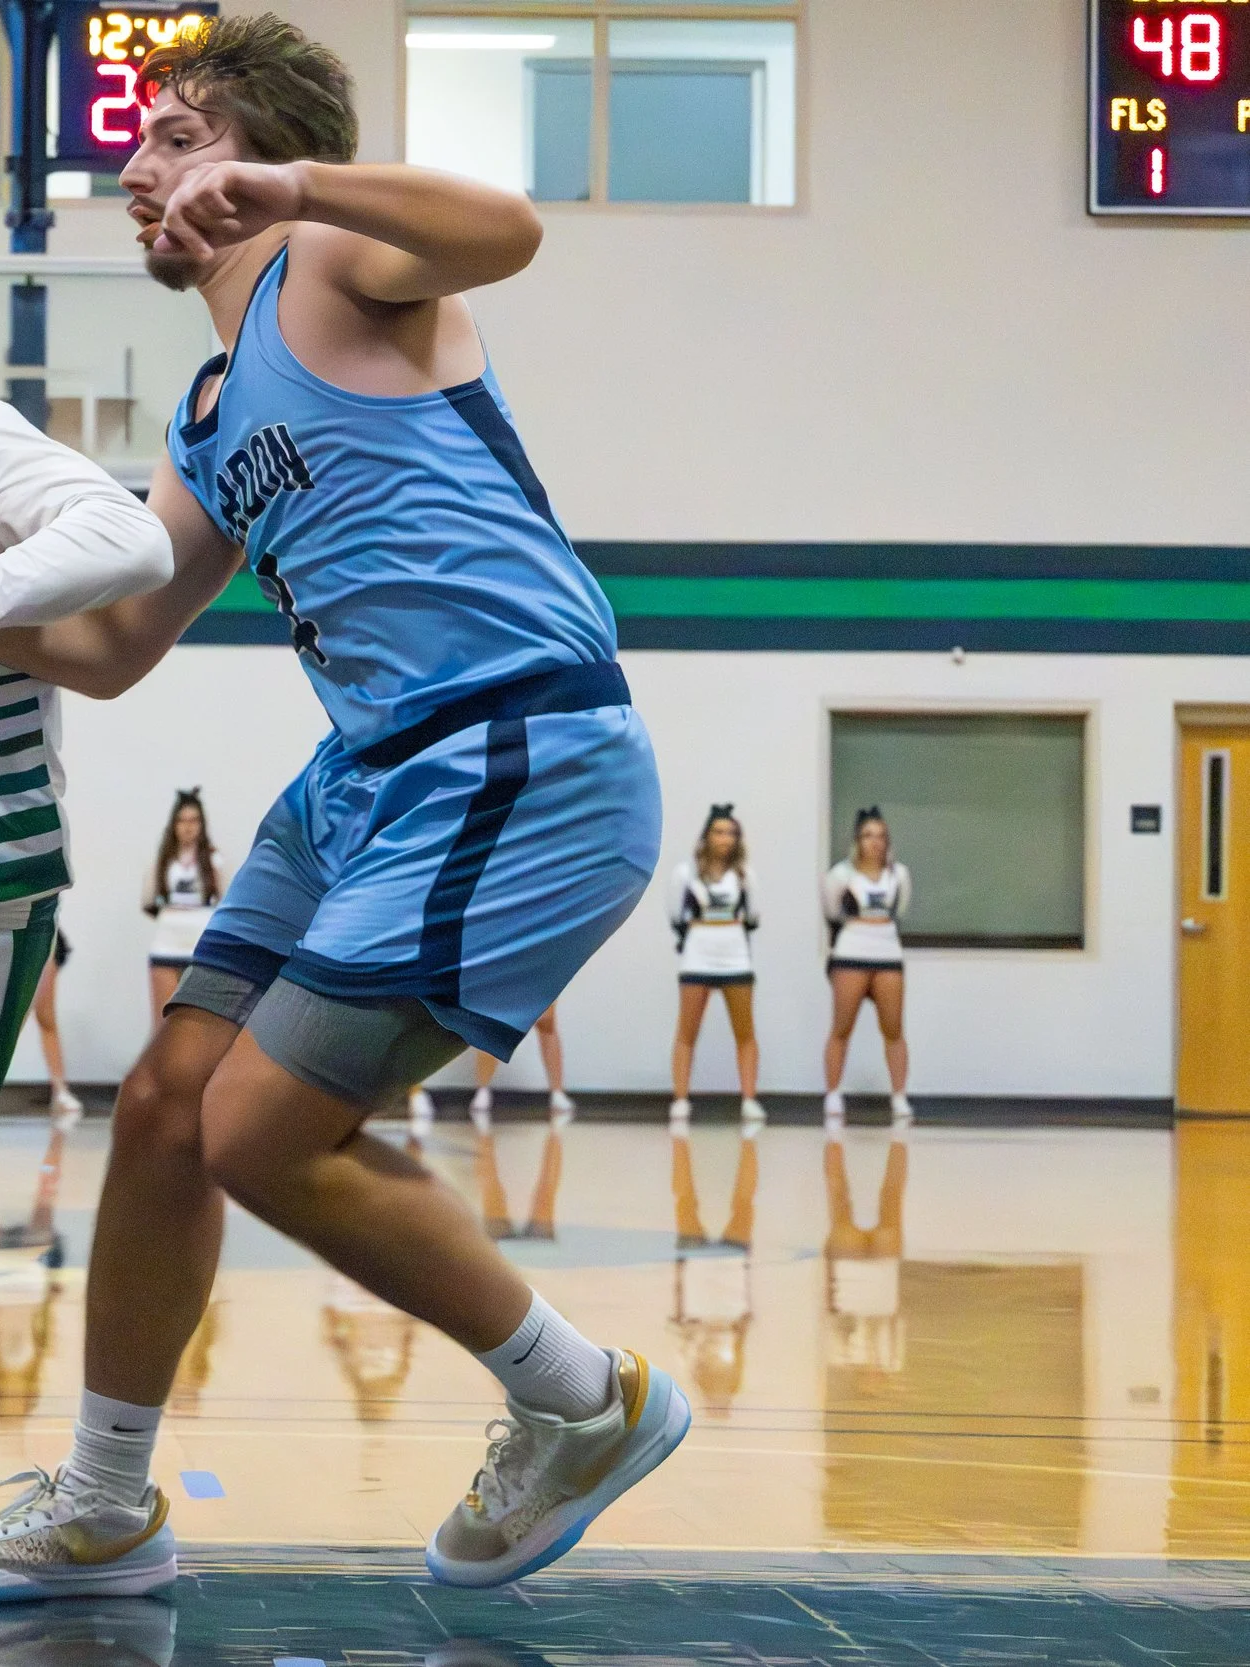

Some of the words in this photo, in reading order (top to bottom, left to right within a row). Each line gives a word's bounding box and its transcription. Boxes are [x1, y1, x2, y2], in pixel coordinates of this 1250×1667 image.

[1134, 14, 1220, 80] 48
[91, 64, 152, 142] 2
[1111, 98, 1167, 131] FLS
[1151, 148, 1163, 194] 1
